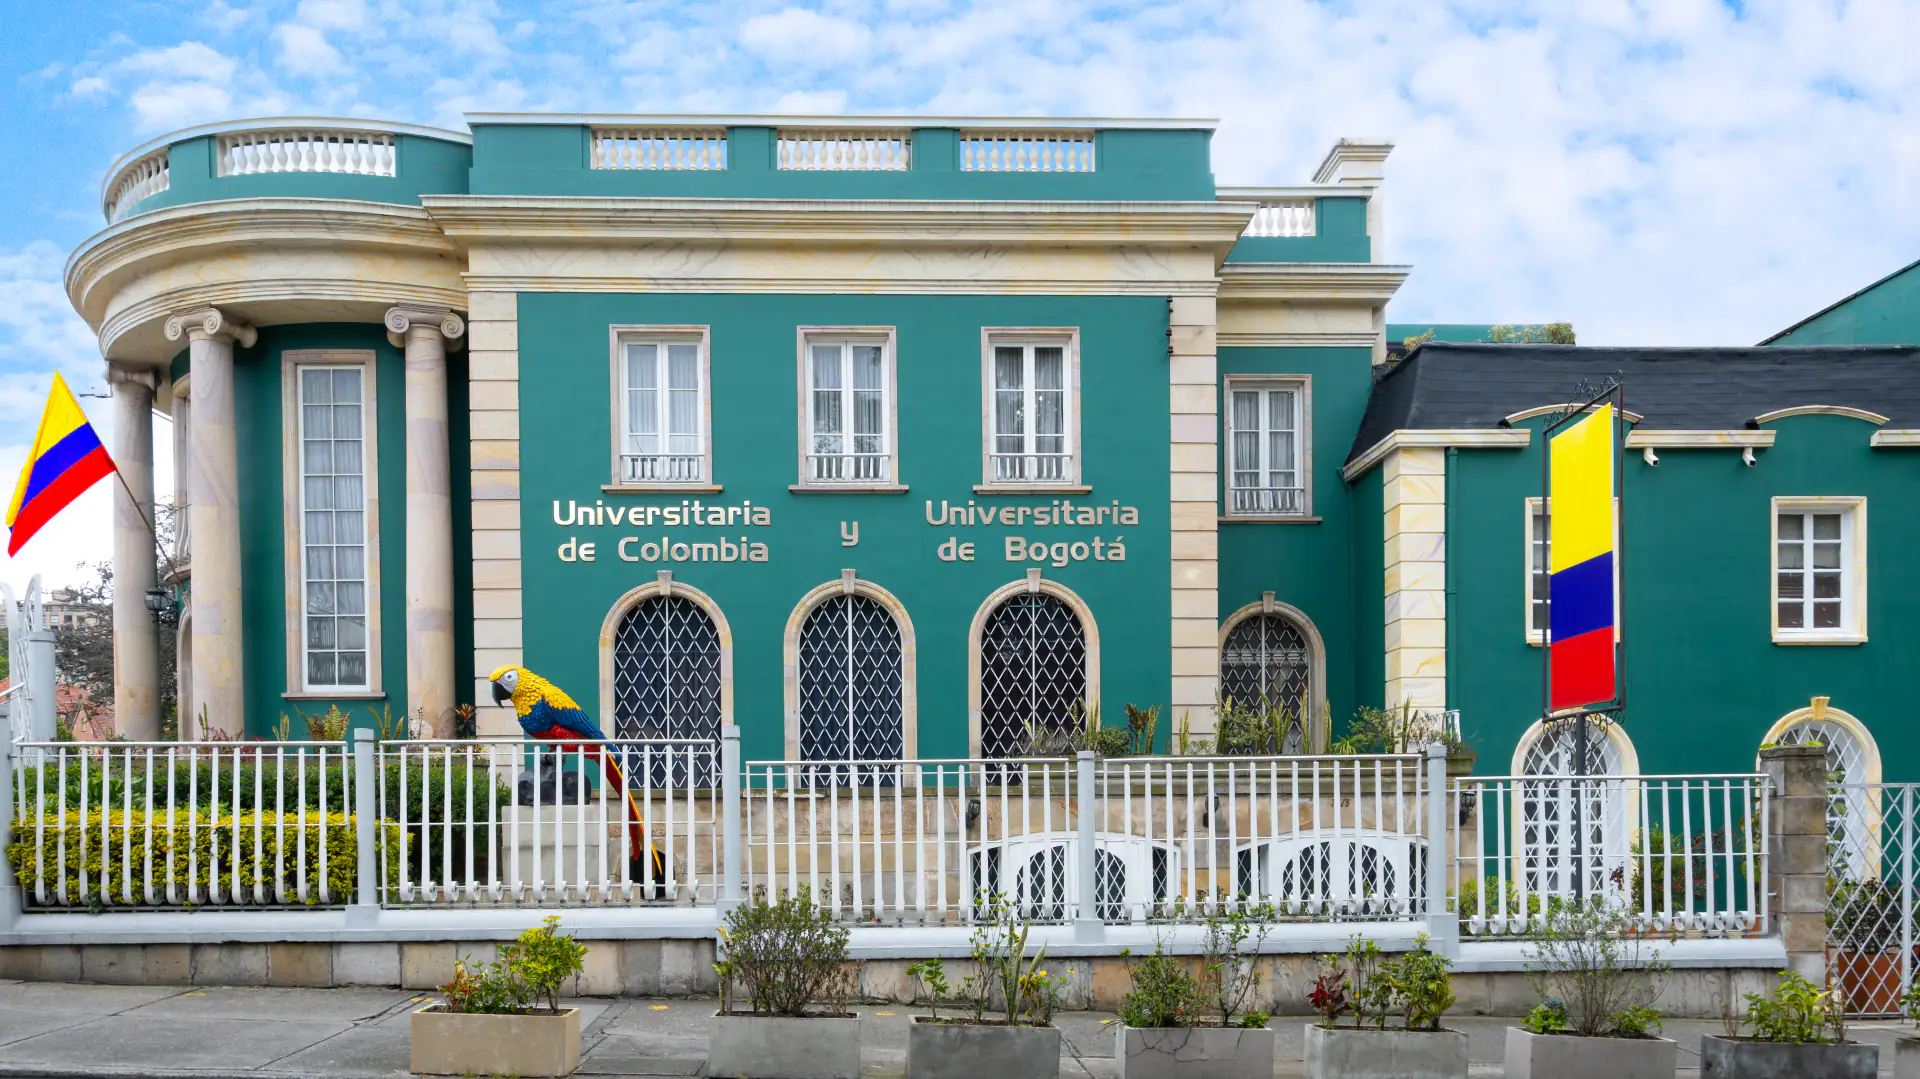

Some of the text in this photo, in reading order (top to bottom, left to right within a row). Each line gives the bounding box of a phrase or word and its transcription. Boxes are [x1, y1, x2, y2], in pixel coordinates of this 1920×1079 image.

[553, 499, 771, 526] Universitaria
[925, 499, 1139, 526] Universitaria
[841, 520, 859, 547] y
[558, 536, 769, 562] de Colombia
[938, 536, 1126, 568] de Bogotá
